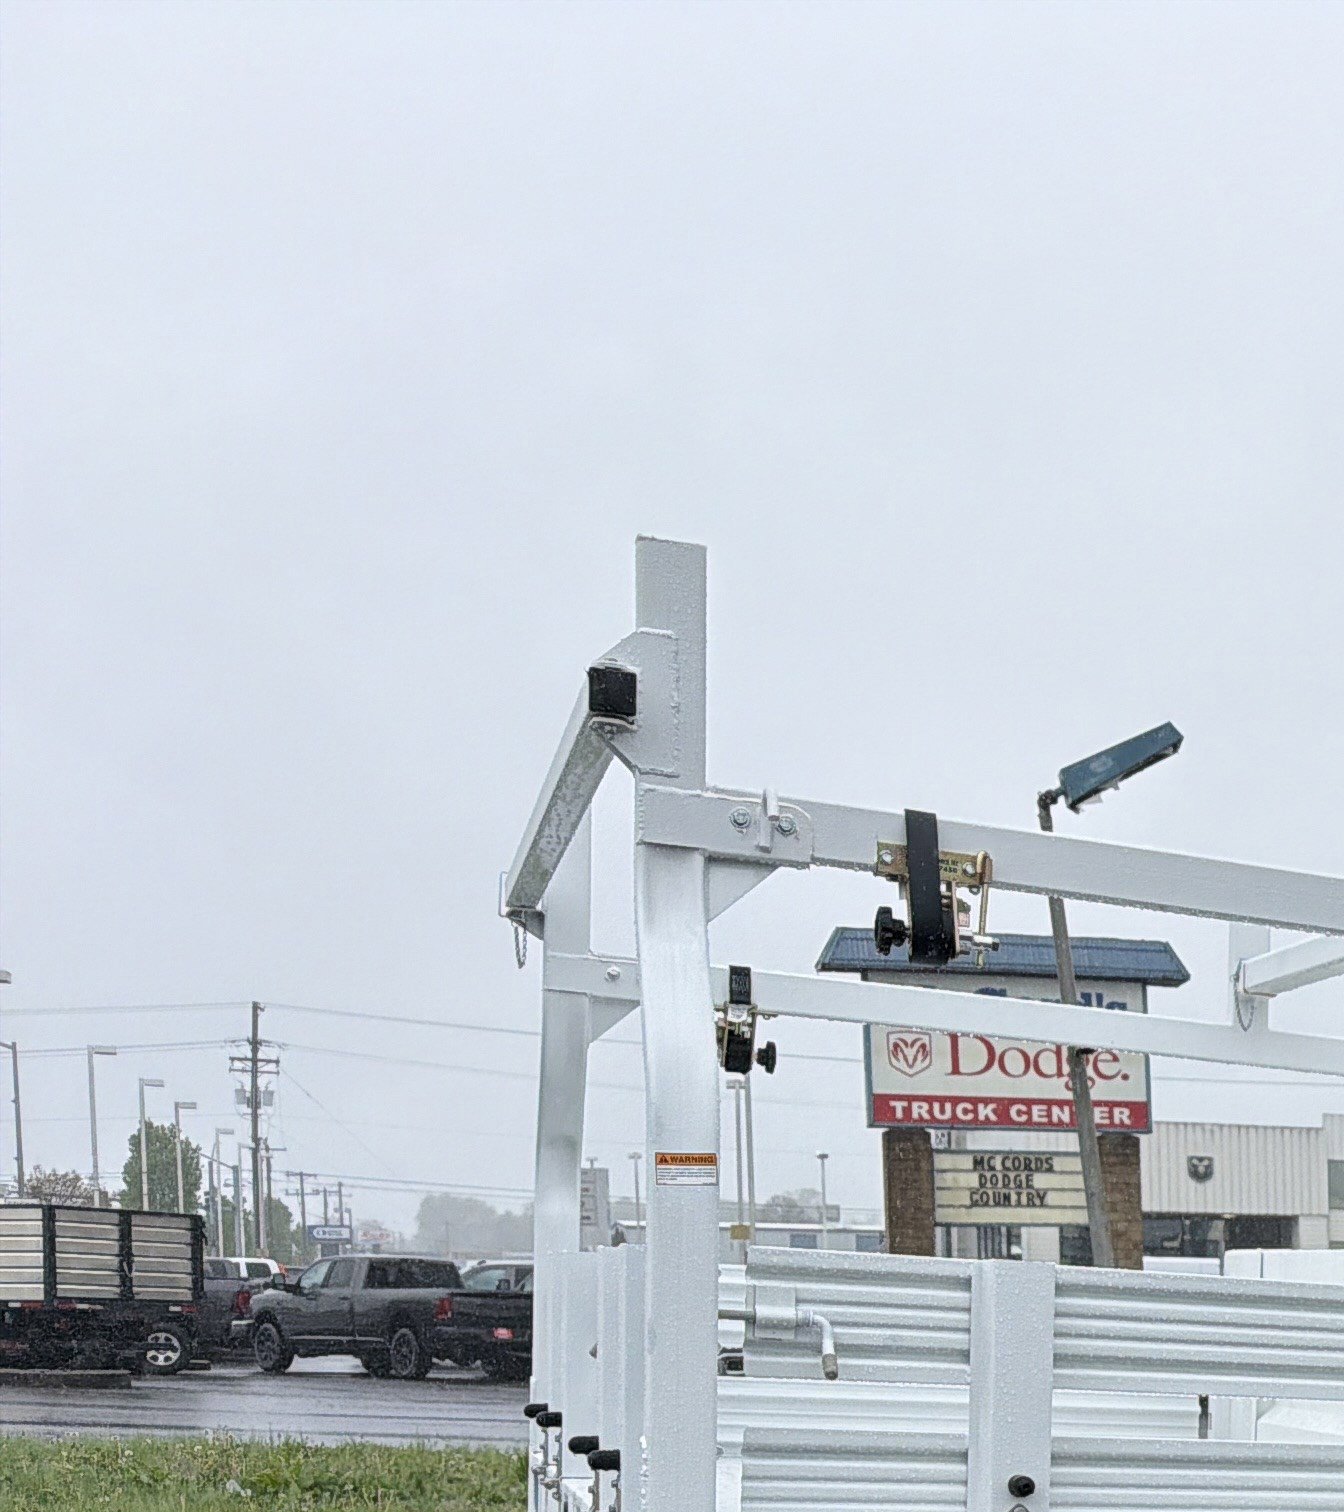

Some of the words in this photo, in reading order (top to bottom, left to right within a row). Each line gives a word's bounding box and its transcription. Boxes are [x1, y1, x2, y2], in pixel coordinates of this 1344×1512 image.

[889, 1100, 998, 1122] TRUCK
[1009, 1103, 1132, 1125] CENER
[669, 1155, 715, 1164] WARNING
[972, 1155, 997, 1172] MC
[1001, 1155, 1055, 1173] CORDS
[978, 1172, 1035, 1189] DODGE
[969, 1190, 1049, 1207] COUNTRY
